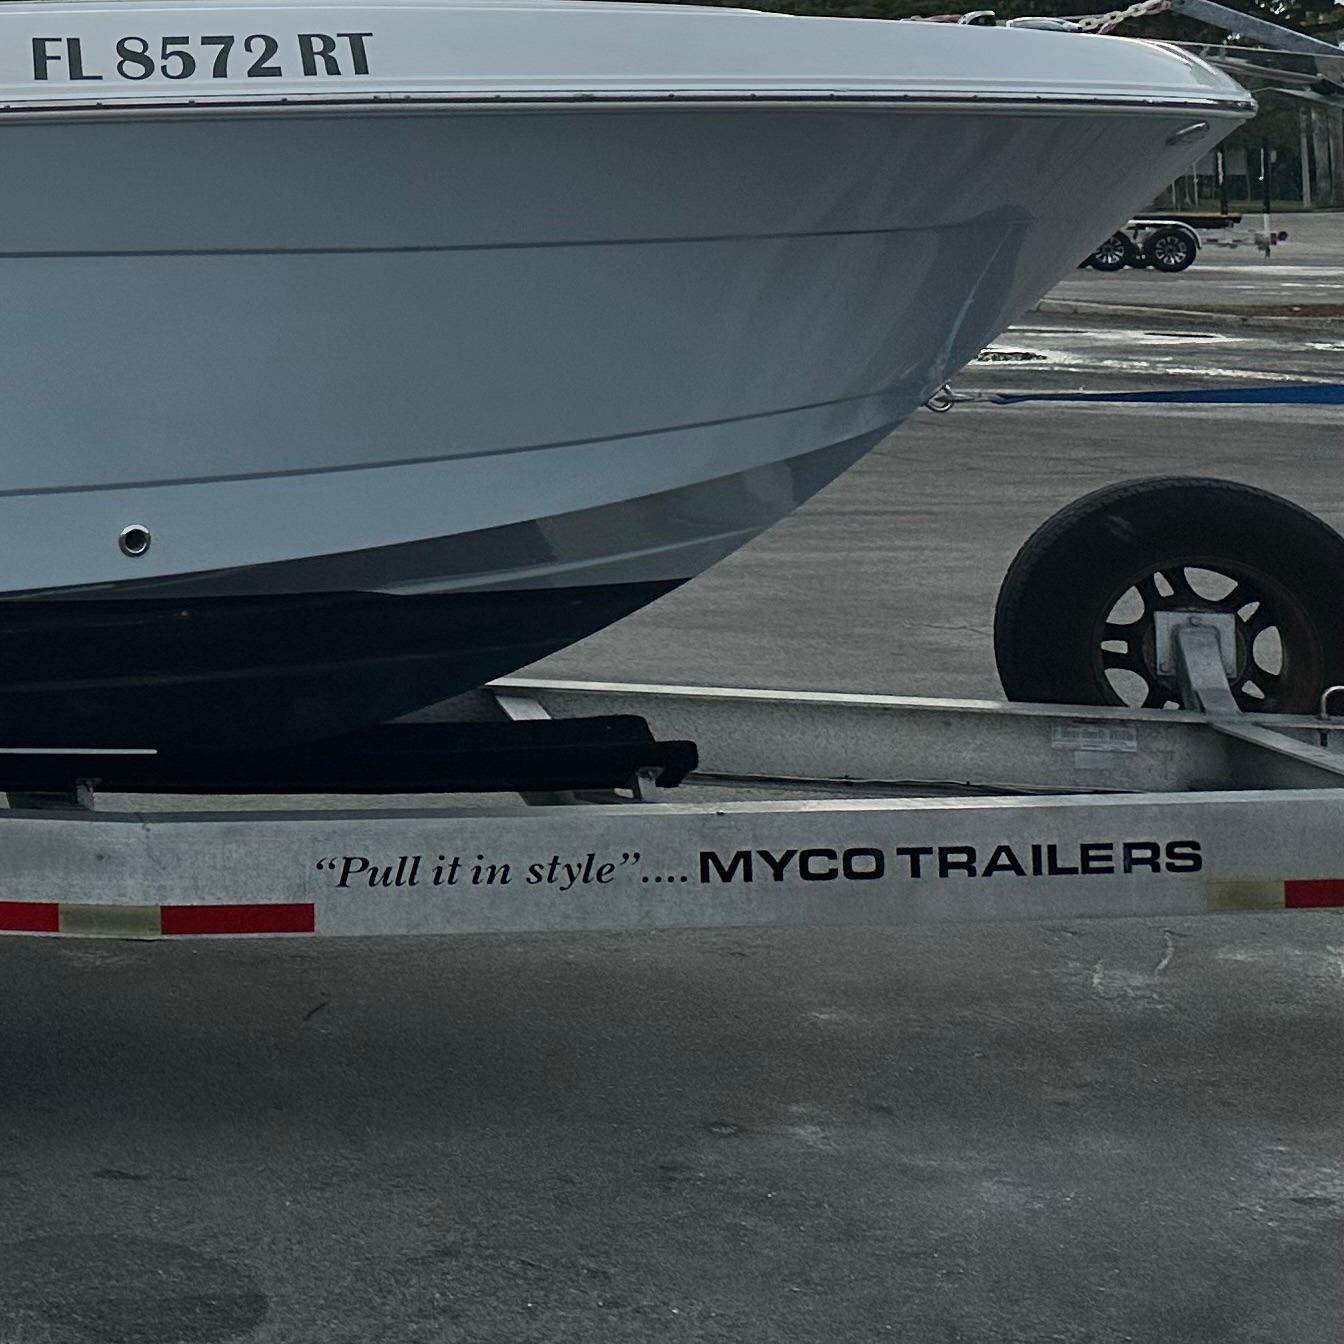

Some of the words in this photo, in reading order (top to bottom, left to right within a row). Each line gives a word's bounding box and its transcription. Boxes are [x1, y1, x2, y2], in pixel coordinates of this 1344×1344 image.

[31, 37, 103, 80] FL
[116, 34, 282, 80] 8572
[297, 32, 373, 76] RT
[433, 855, 461, 886] it
[471, 855, 512, 886] in
[700, 848, 885, 883] MYCO
[896, 840, 1202, 879] TRAILERS
